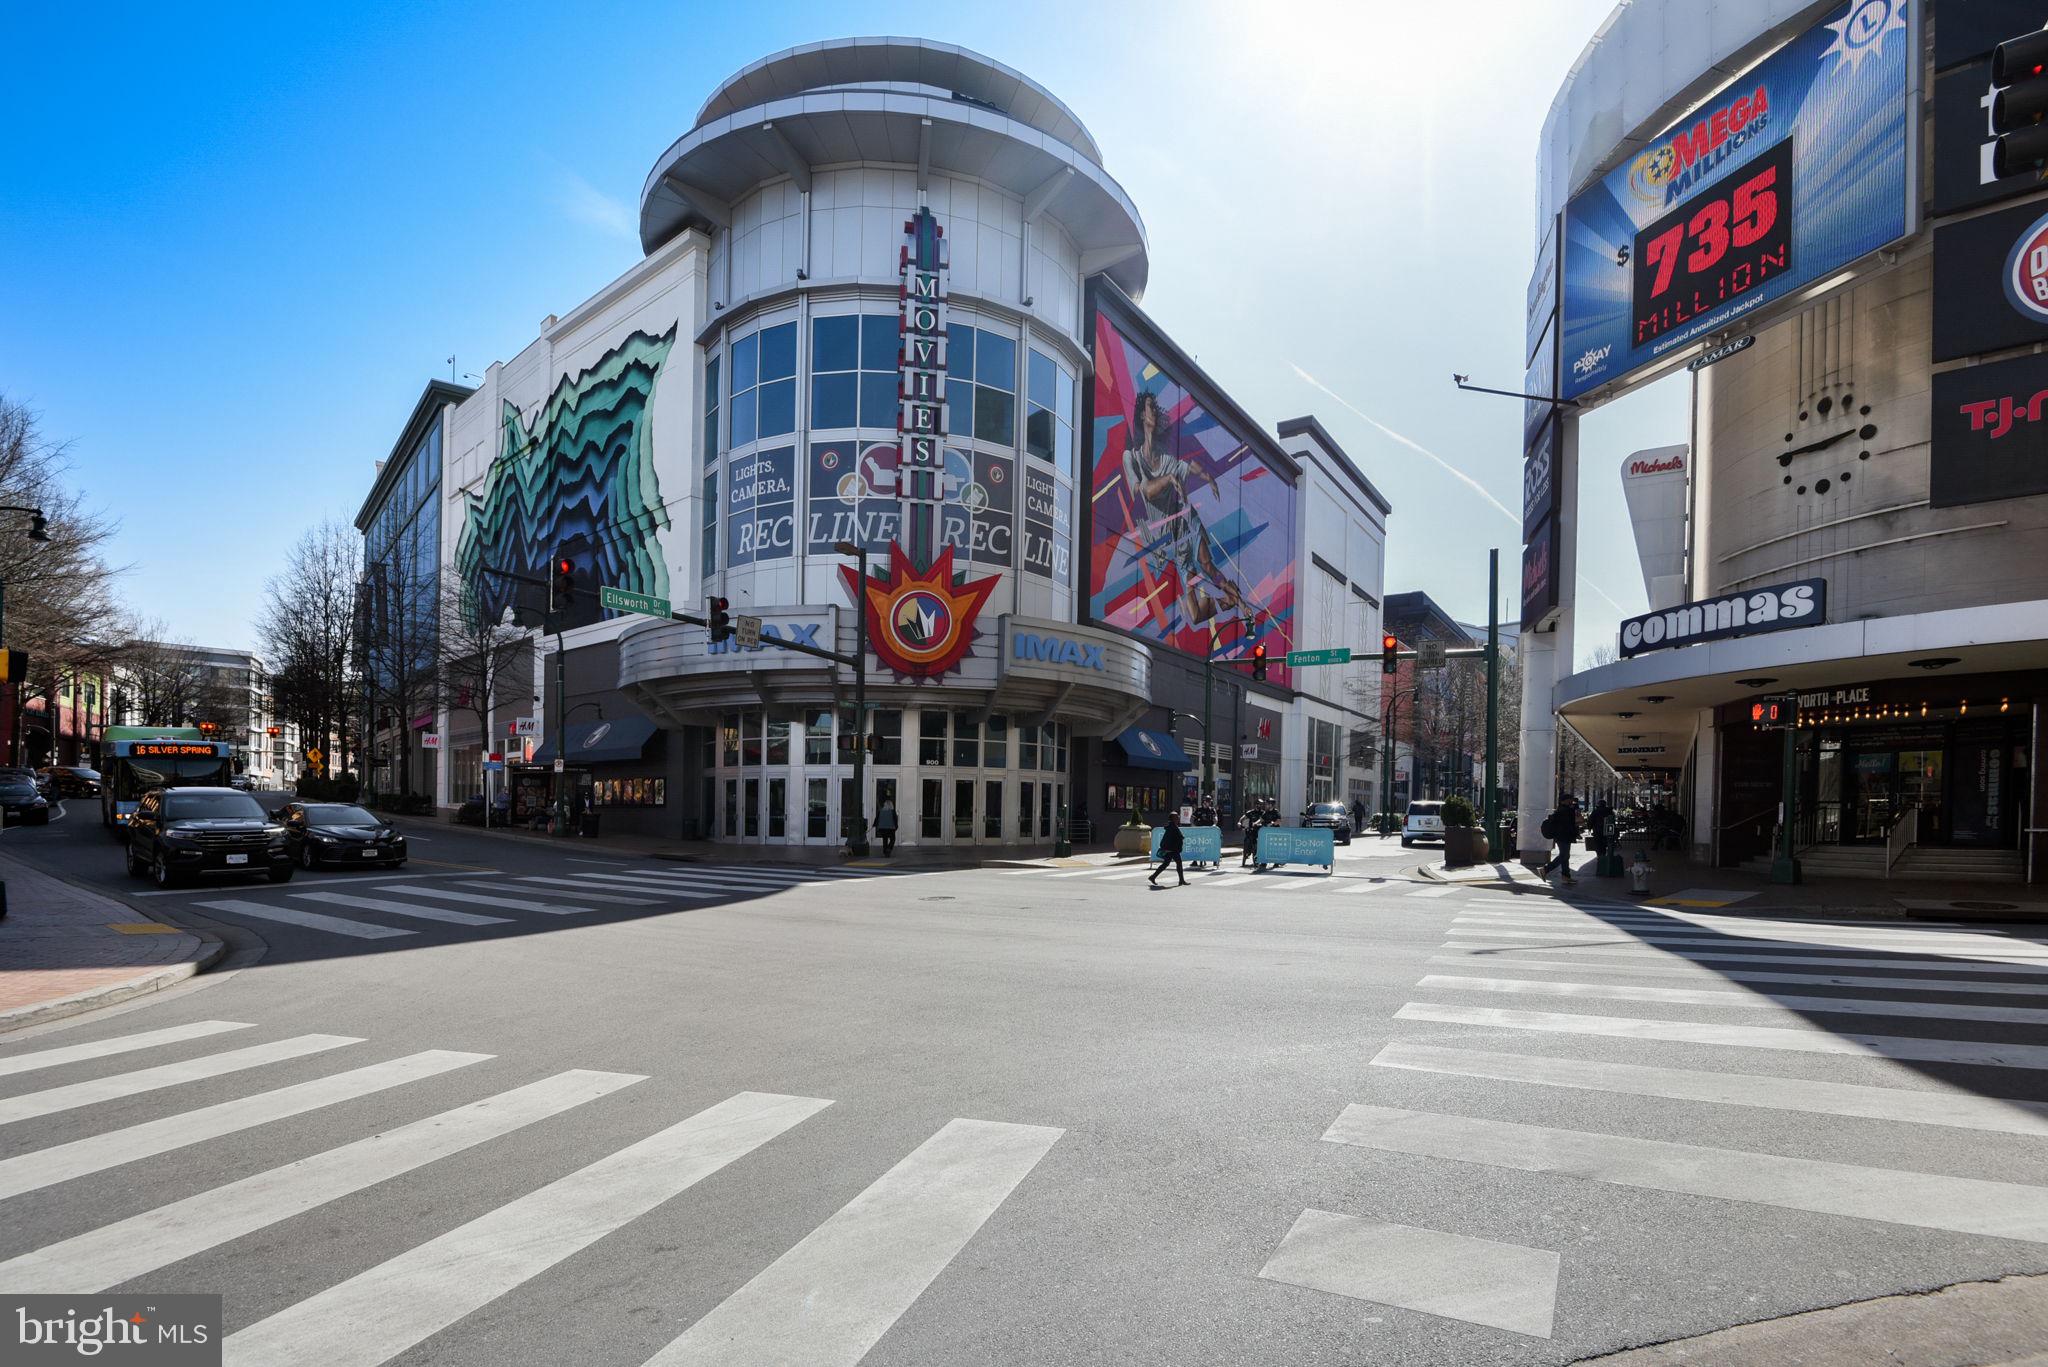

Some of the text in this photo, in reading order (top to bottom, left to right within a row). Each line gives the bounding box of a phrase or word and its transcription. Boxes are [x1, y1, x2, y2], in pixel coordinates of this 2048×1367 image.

[1668, 84, 1769, 181] MEGA
[1666, 114, 1768, 207] MILLIONS
[1617, 244, 1630, 268] $
[1646, 165, 1779, 299] 735
[1638, 243, 1785, 342] MILLION
[1652, 293, 1764, 355] Estimated Annuitized Jackpot
[1691, 340, 1746, 371] LAMAR
[914, 277, 937, 462] MOVIES
[735, 460, 775, 482] LIGHTS,
[1525, 436, 1551, 503] ROSS
[1630, 456, 1683, 475] Michaels
[731, 477, 790, 503] CAMERA,
[607, 592, 660, 610] Ellsworth Dr
[745, 620, 755, 628] NO
[1623, 585, 1815, 649] commas
[738, 635, 746, 643] ON
[742, 627, 756, 637] TURN
[1015, 633, 1104, 671] IMAX
[1294, 655, 1320, 663] Fenton
[1836, 688, 1869, 705] PLACE
[1770, 705, 1778, 720] 0
[136, 746, 212, 755] 16 SILVER SPRING
[1185, 845, 1206, 853] Enter
[1186, 837, 1213, 846] Do Not
[1295, 839, 1324, 847] Do Not
[1295, 848, 1317, 856] Enter
